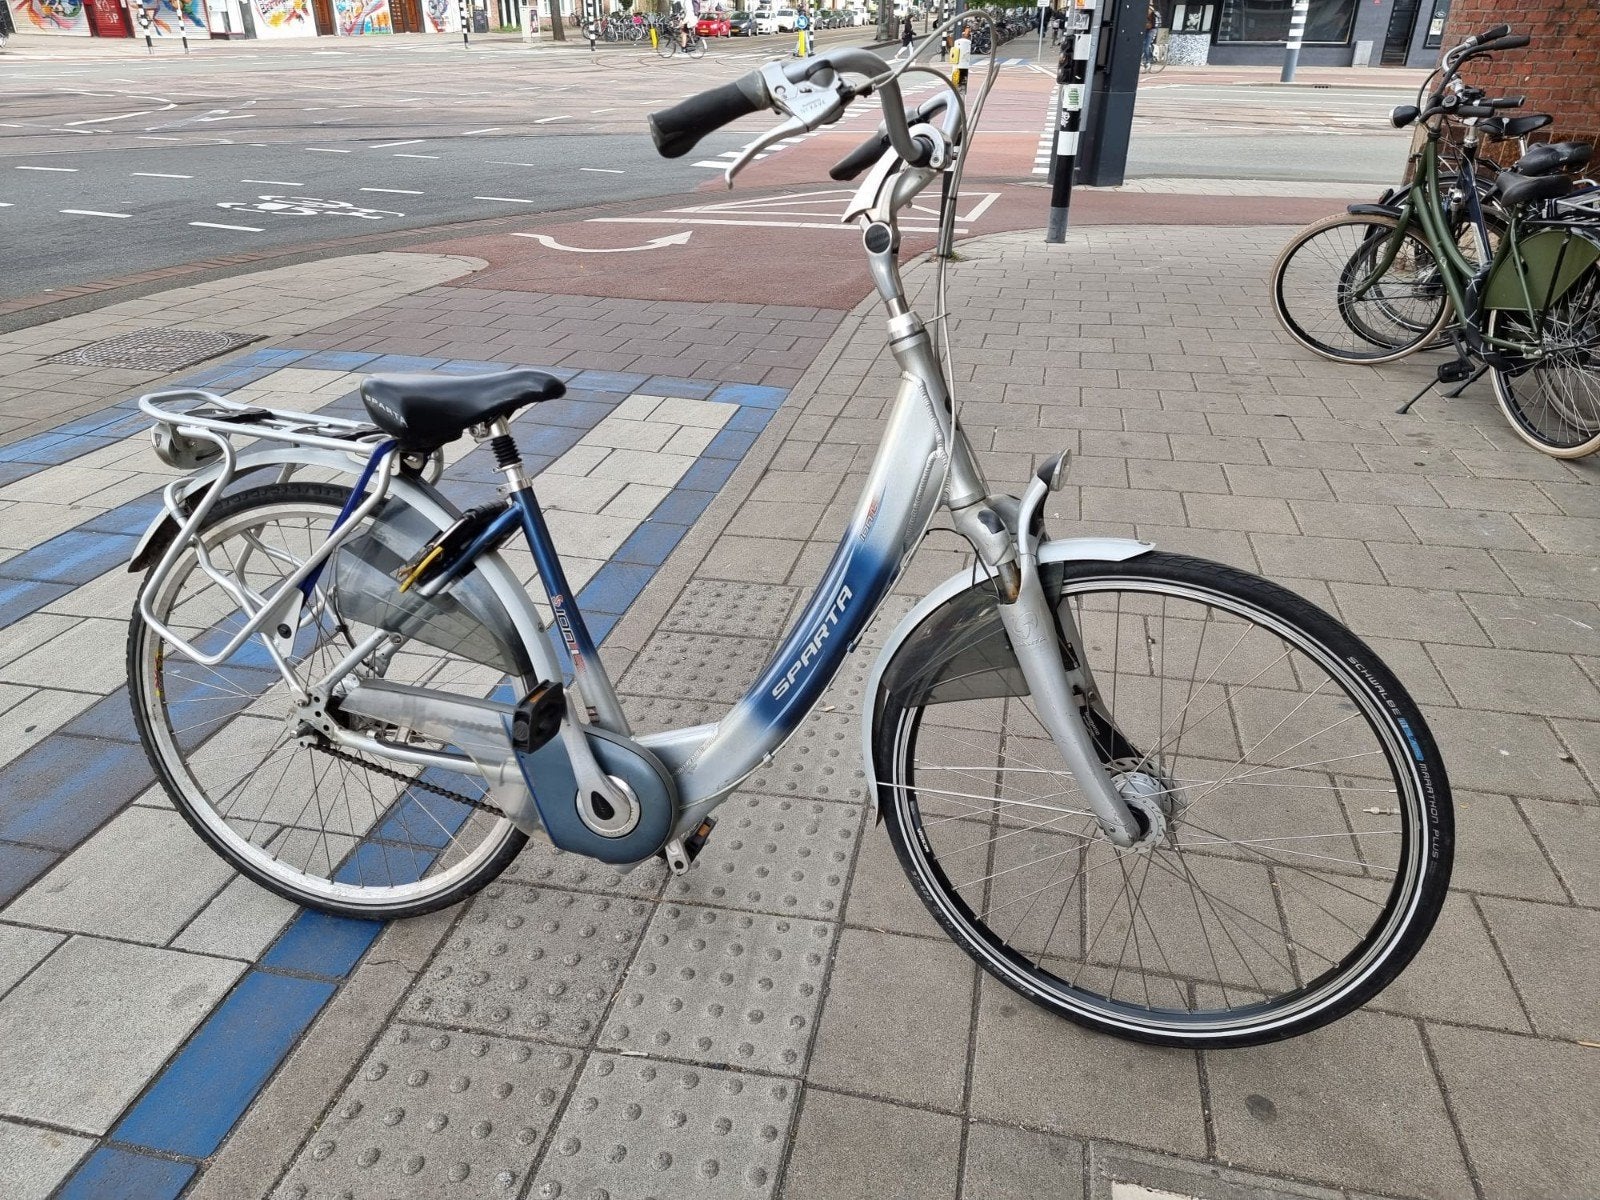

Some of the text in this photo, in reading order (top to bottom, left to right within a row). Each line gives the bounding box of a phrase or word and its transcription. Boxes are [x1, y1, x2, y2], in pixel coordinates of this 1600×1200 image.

[364, 394, 409, 428] SPARTA
[771, 584, 853, 701] SPARTA
[1346, 656, 1401, 716] SCHWALBE
[1419, 763, 1440, 824] MARATHON
[1431, 828, 1440, 859] PLUS
